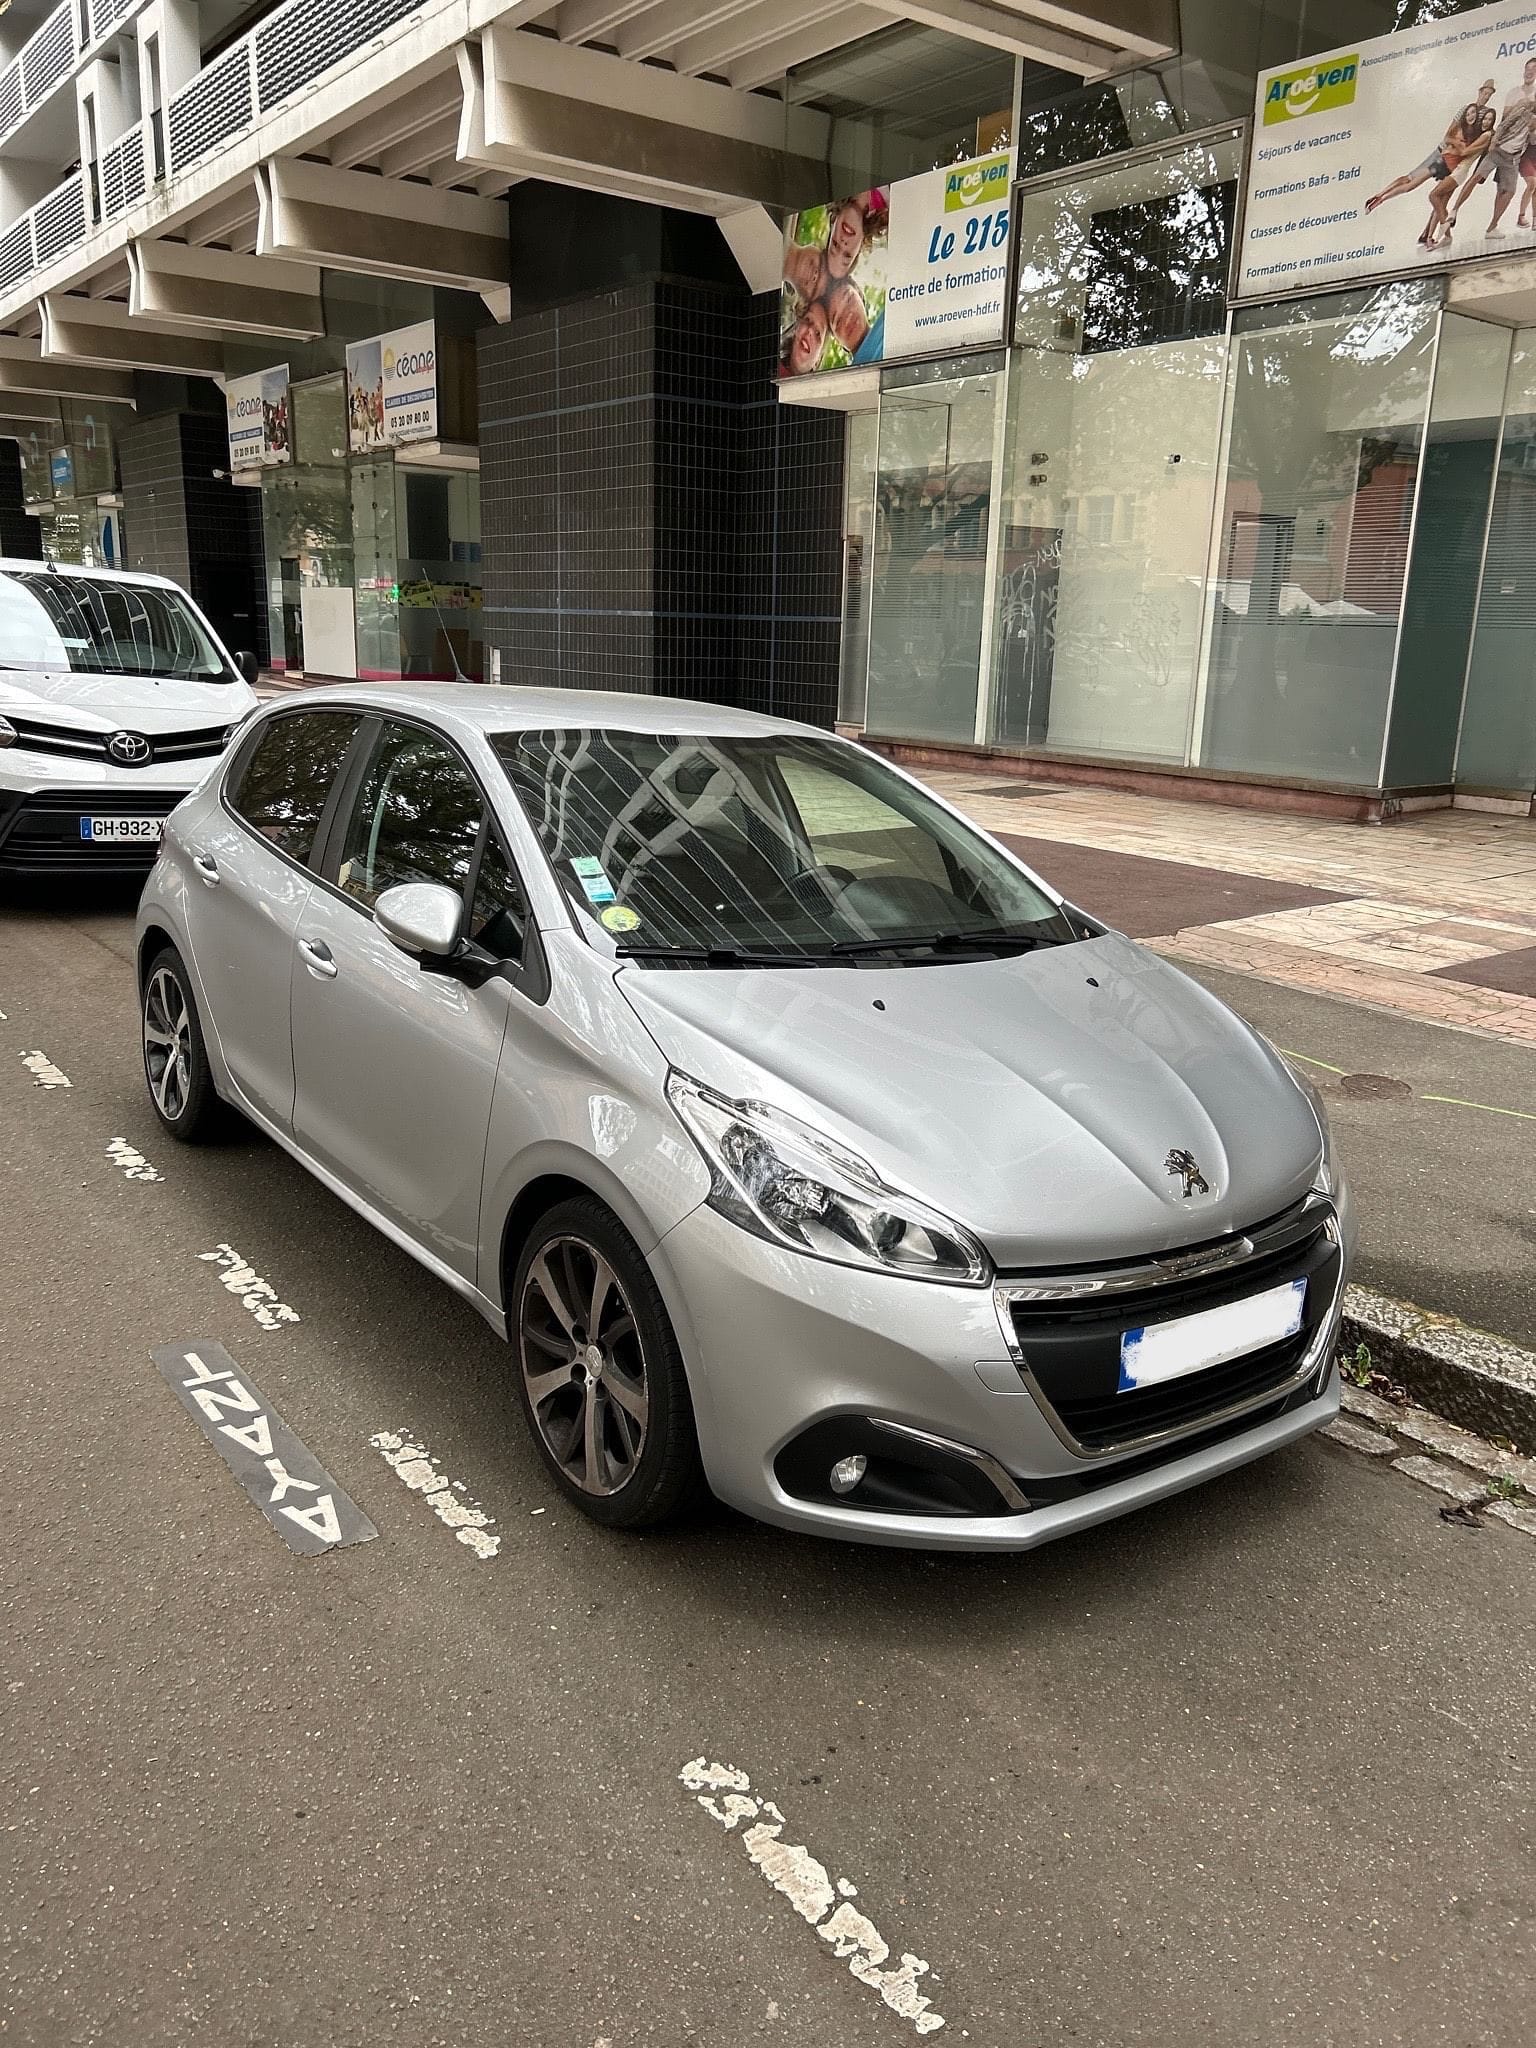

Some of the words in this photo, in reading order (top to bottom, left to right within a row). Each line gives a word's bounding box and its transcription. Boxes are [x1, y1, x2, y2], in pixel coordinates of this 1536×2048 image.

[1361, 50, 1403, 68] Association
[1444, 33, 1458, 46] des
[1460, 26, 1494, 41] Oeuvres
[1266, 63, 1357, 104] Aroéven
[1258, 141, 1292, 161] Séjours
[1294, 139, 1306, 152] de
[1308, 130, 1352, 148] vacances
[946, 164, 1009, 194] Aroéven
[1254, 179, 1306, 200] Formations
[1308, 173, 1330, 189] Bafa
[1338, 166, 1361, 181] Bafd
[928, 225, 955, 264] Le
[963, 209, 1009, 255] 215
[1250, 222, 1283, 240] Classes
[1284, 219, 1297, 232] de
[1298, 208, 1358, 229] découvertes
[1246, 258, 1297, 279] Formations
[1299, 256, 1312, 269] en
[1313, 251, 1343, 267] milieu
[1346, 244, 1385, 261] scolaire
[888, 283, 925, 302] Centre
[928, 277, 943, 294] de
[945, 265, 1006, 290] formation
[915, 301, 1000, 328] www.aroeven-hdf.fr
